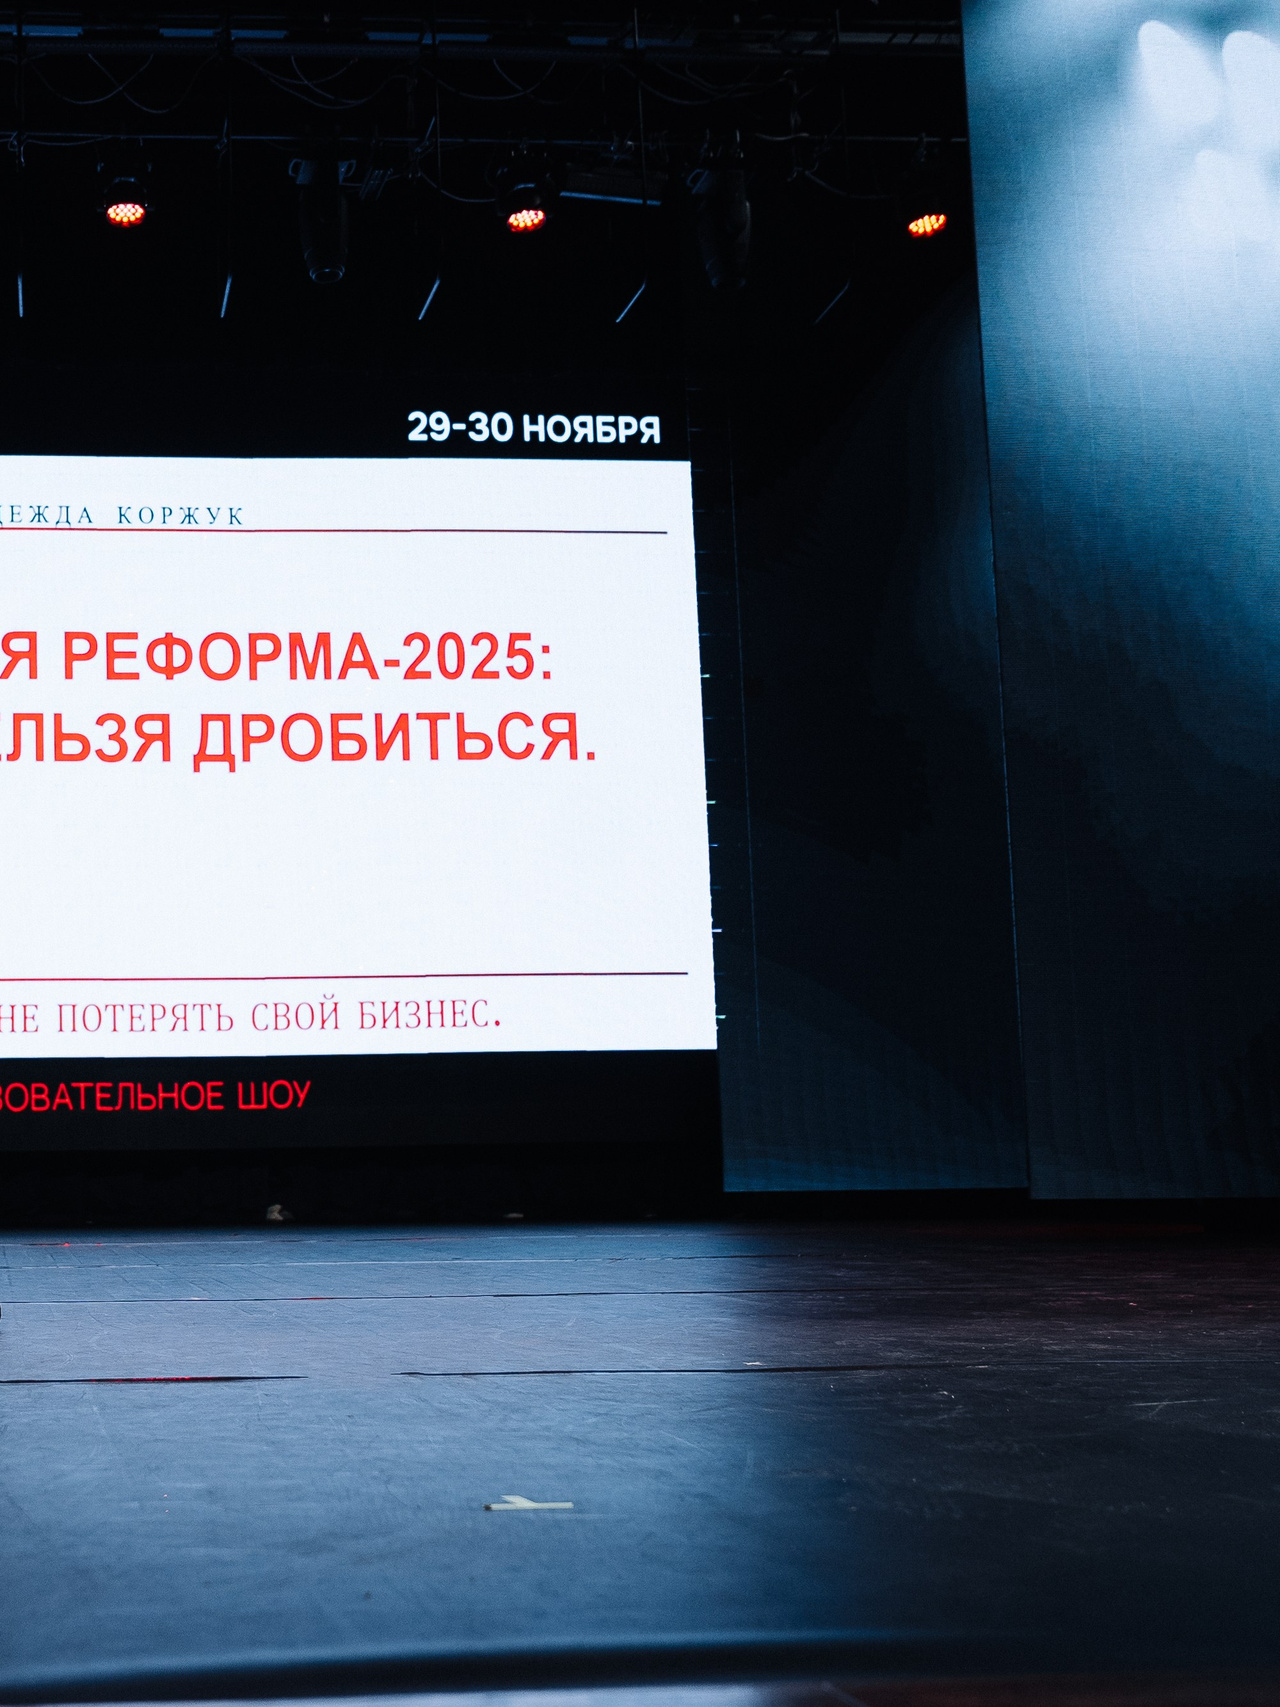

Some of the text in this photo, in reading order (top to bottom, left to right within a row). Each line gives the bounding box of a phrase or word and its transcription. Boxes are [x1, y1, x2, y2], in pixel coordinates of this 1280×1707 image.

[407, 410, 662, 444] 29-30 НОЯБРЯ
[117, 506, 244, 526] КОРЖУК
[63, 630, 552, 682] РЕФОРМА-2025:
[192, 710, 597, 774] ДРОБИТЬСЯ.
[57, 1003, 234, 1033] ПОТЕРЯТЬ
[251, 993, 340, 1031] СВОЙ
[359, 999, 502, 1030] БИЗНЕС.
[237, 1079, 312, 1110] ШОУ
